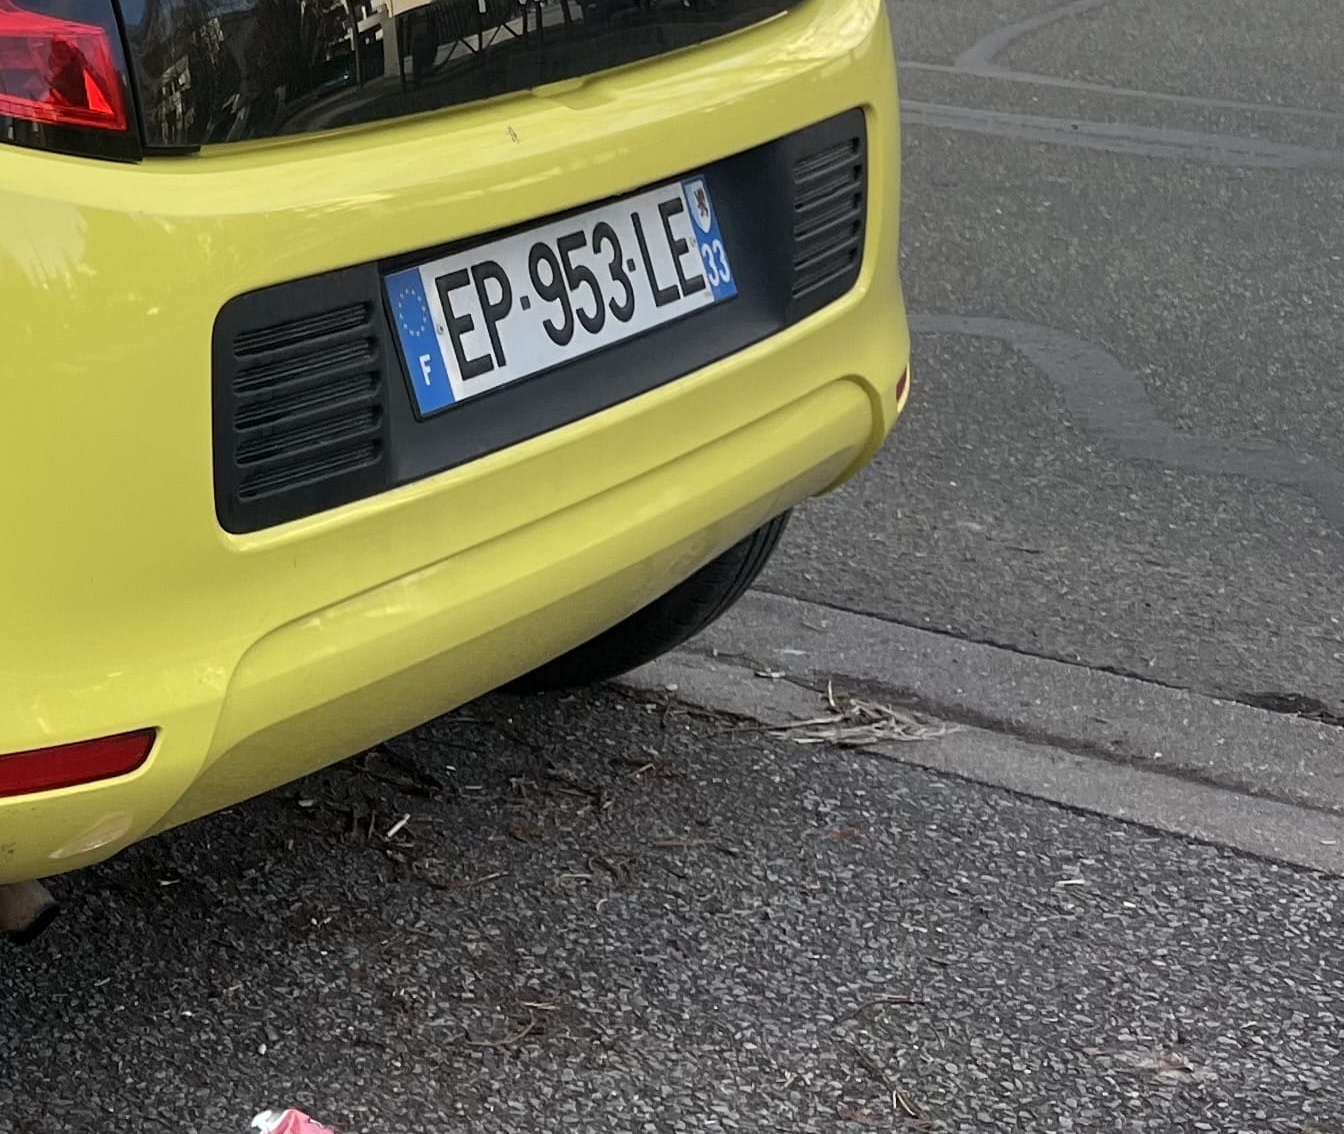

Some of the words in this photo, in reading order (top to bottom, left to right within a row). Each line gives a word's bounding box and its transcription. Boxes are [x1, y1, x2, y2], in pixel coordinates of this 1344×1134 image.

[701, 239, 731, 287] 33
[435, 197, 706, 381] EP-953-LE
[419, 354, 431, 386] F
